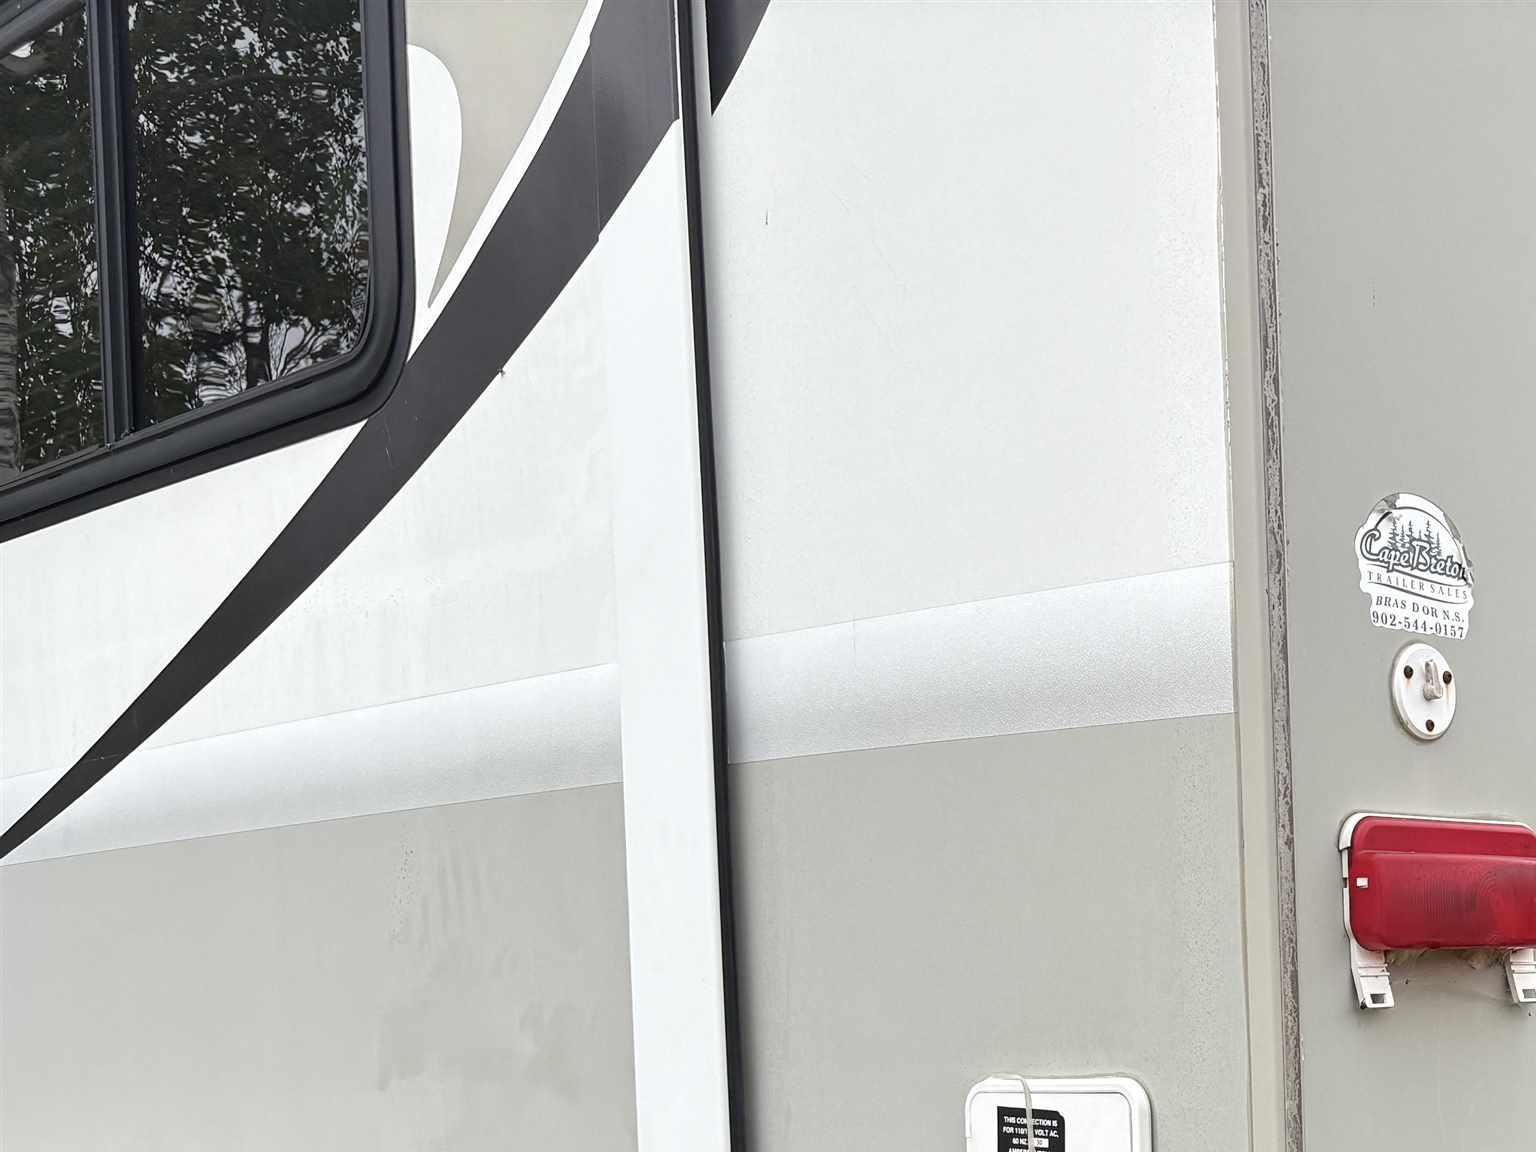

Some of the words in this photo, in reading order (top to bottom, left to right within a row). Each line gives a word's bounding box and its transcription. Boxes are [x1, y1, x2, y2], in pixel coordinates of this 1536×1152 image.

[1360, 528, 1411, 573] Cape
[1367, 570, 1425, 592] TRAILER
[1429, 585, 1469, 600] SALES
[1375, 595, 1408, 610] BRAS
[1371, 610, 1465, 639] 902-544-0157
[1002, 1126, 1015, 1134] FOR
[1003, 1115, 1016, 1124] THIS
